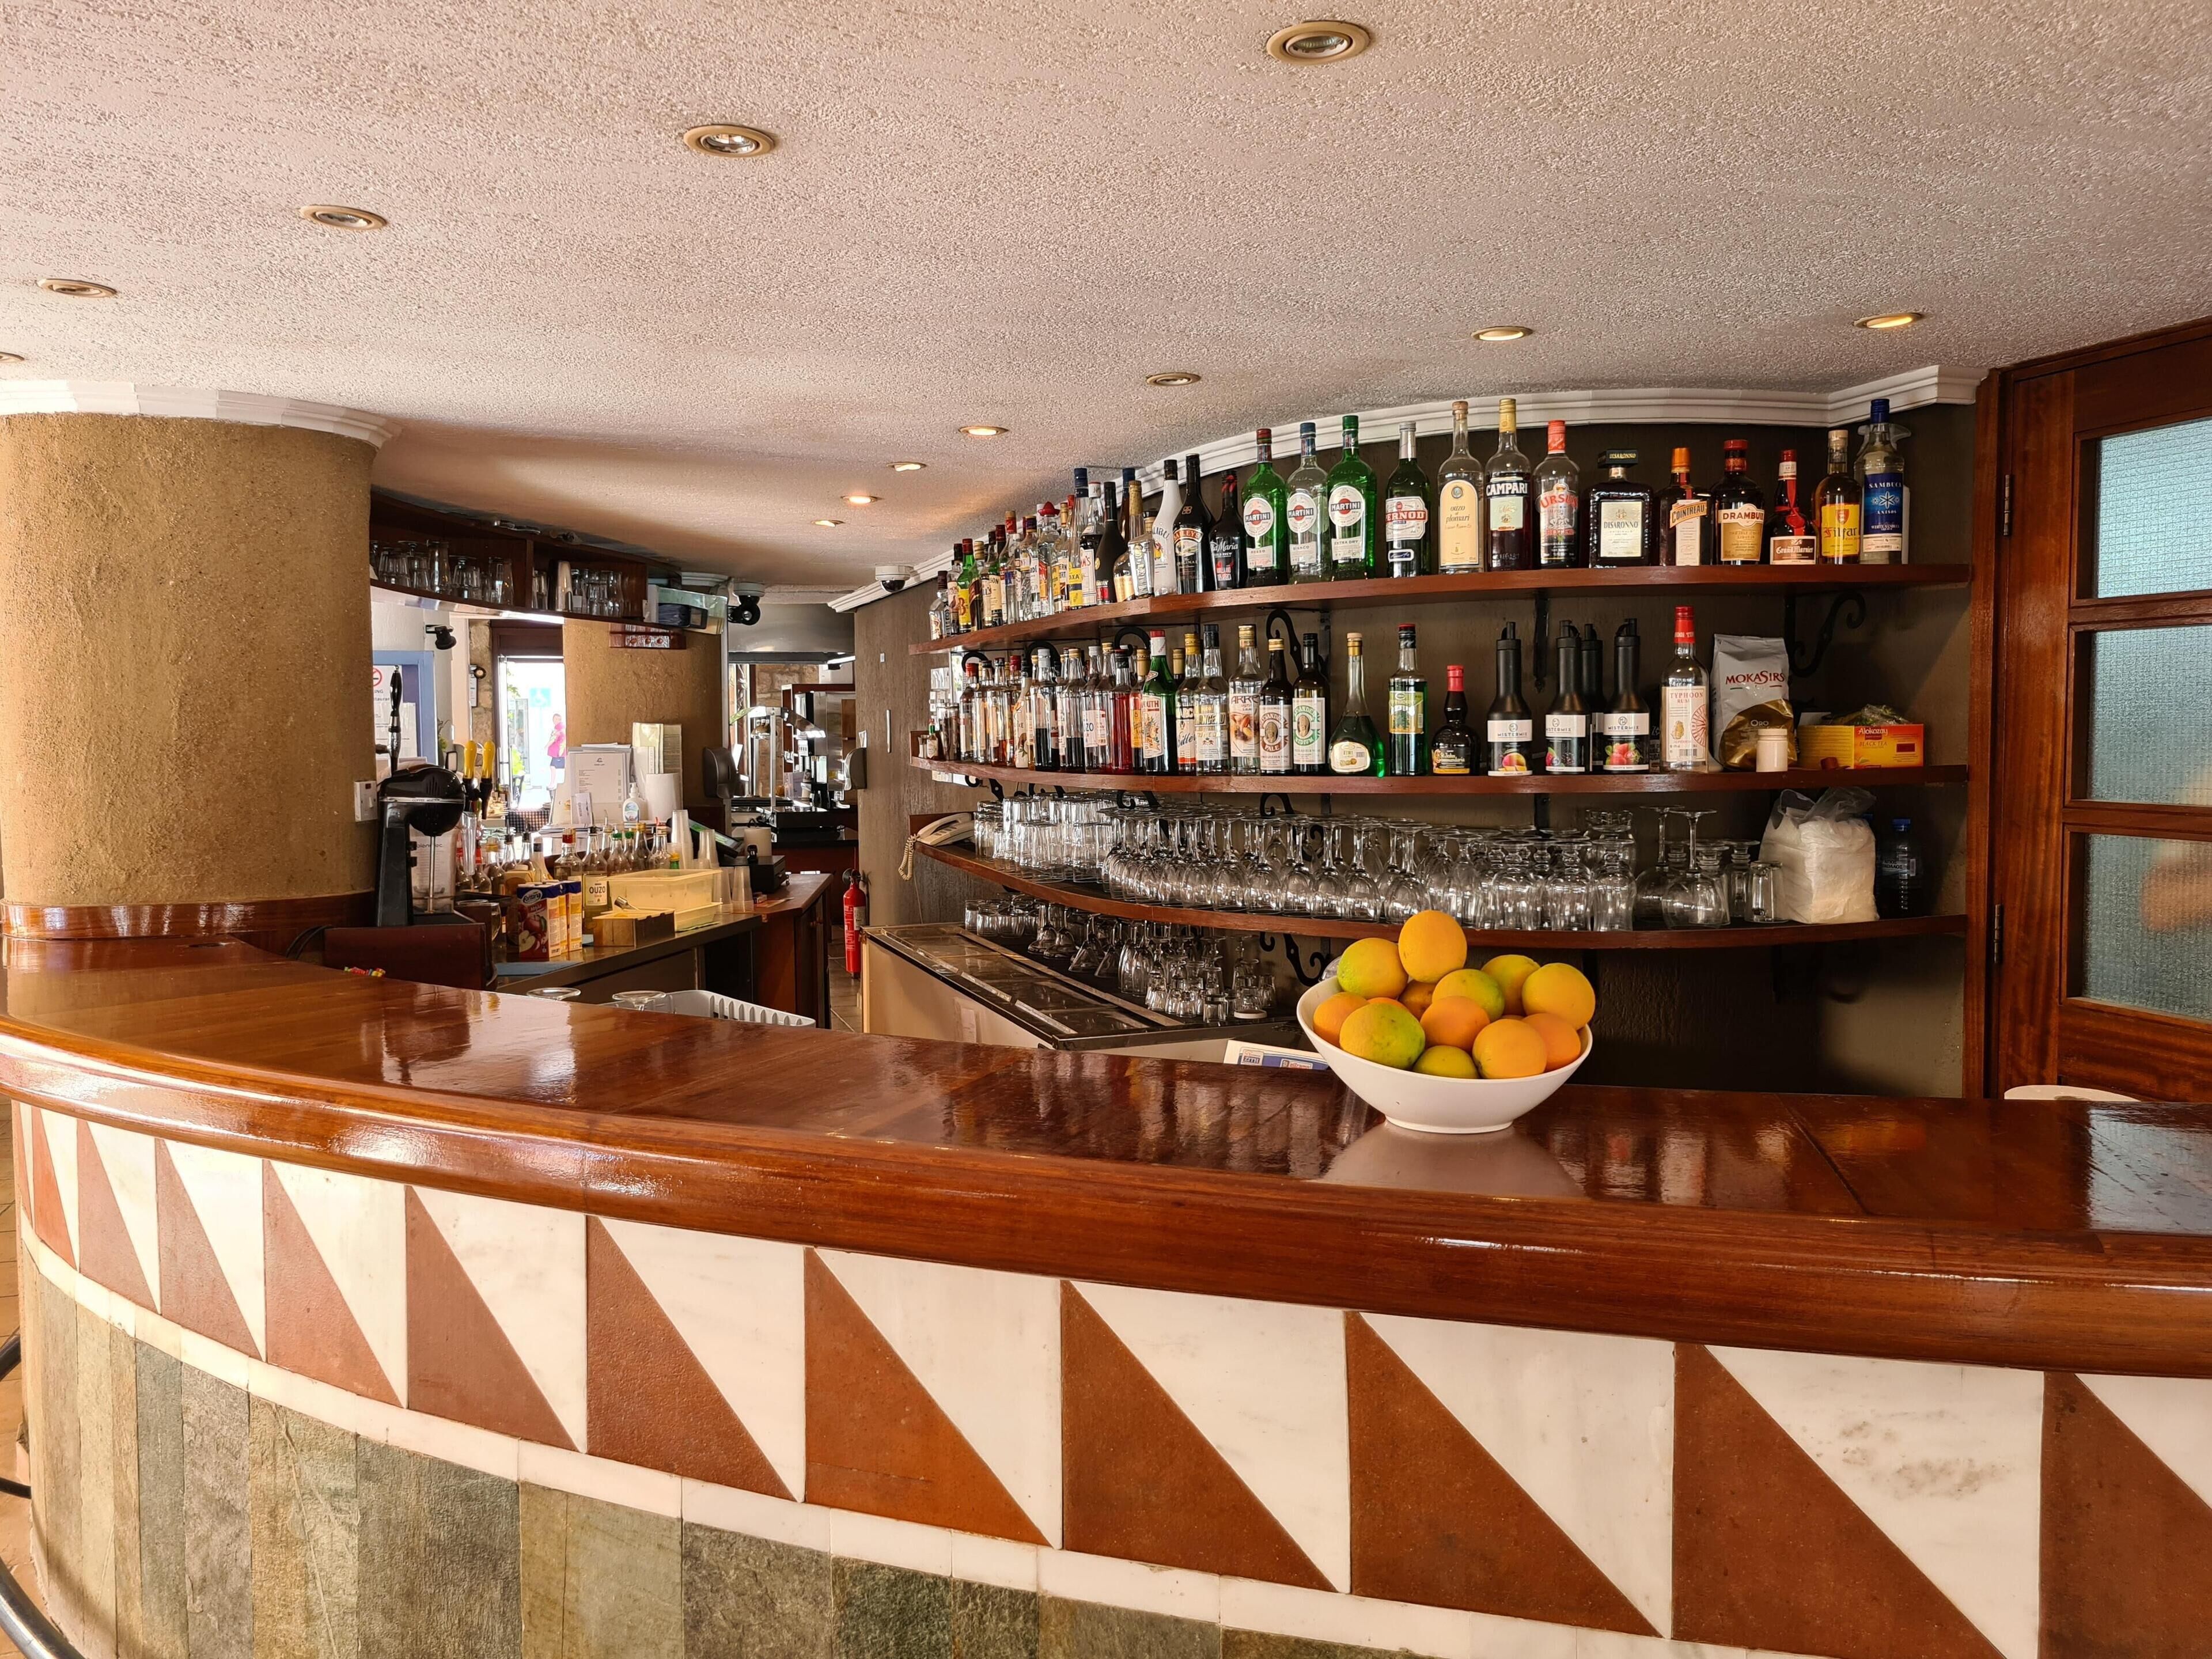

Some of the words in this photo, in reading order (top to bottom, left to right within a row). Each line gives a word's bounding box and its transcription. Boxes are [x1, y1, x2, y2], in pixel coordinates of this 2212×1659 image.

[1486, 482, 1528, 496] CAMPARI
[1331, 502, 1361, 512] MARTINI
[1245, 512, 1271, 522] MARTINI
[1288, 508, 1313, 518] MARTINI
[1672, 503, 1706, 524] COINTREAU
[1446, 514, 1471, 524] plomari
[1604, 521, 1639, 529] DISARONNO
[1217, 539, 1238, 552] Maria
[589, 886, 606, 894] OUZO
